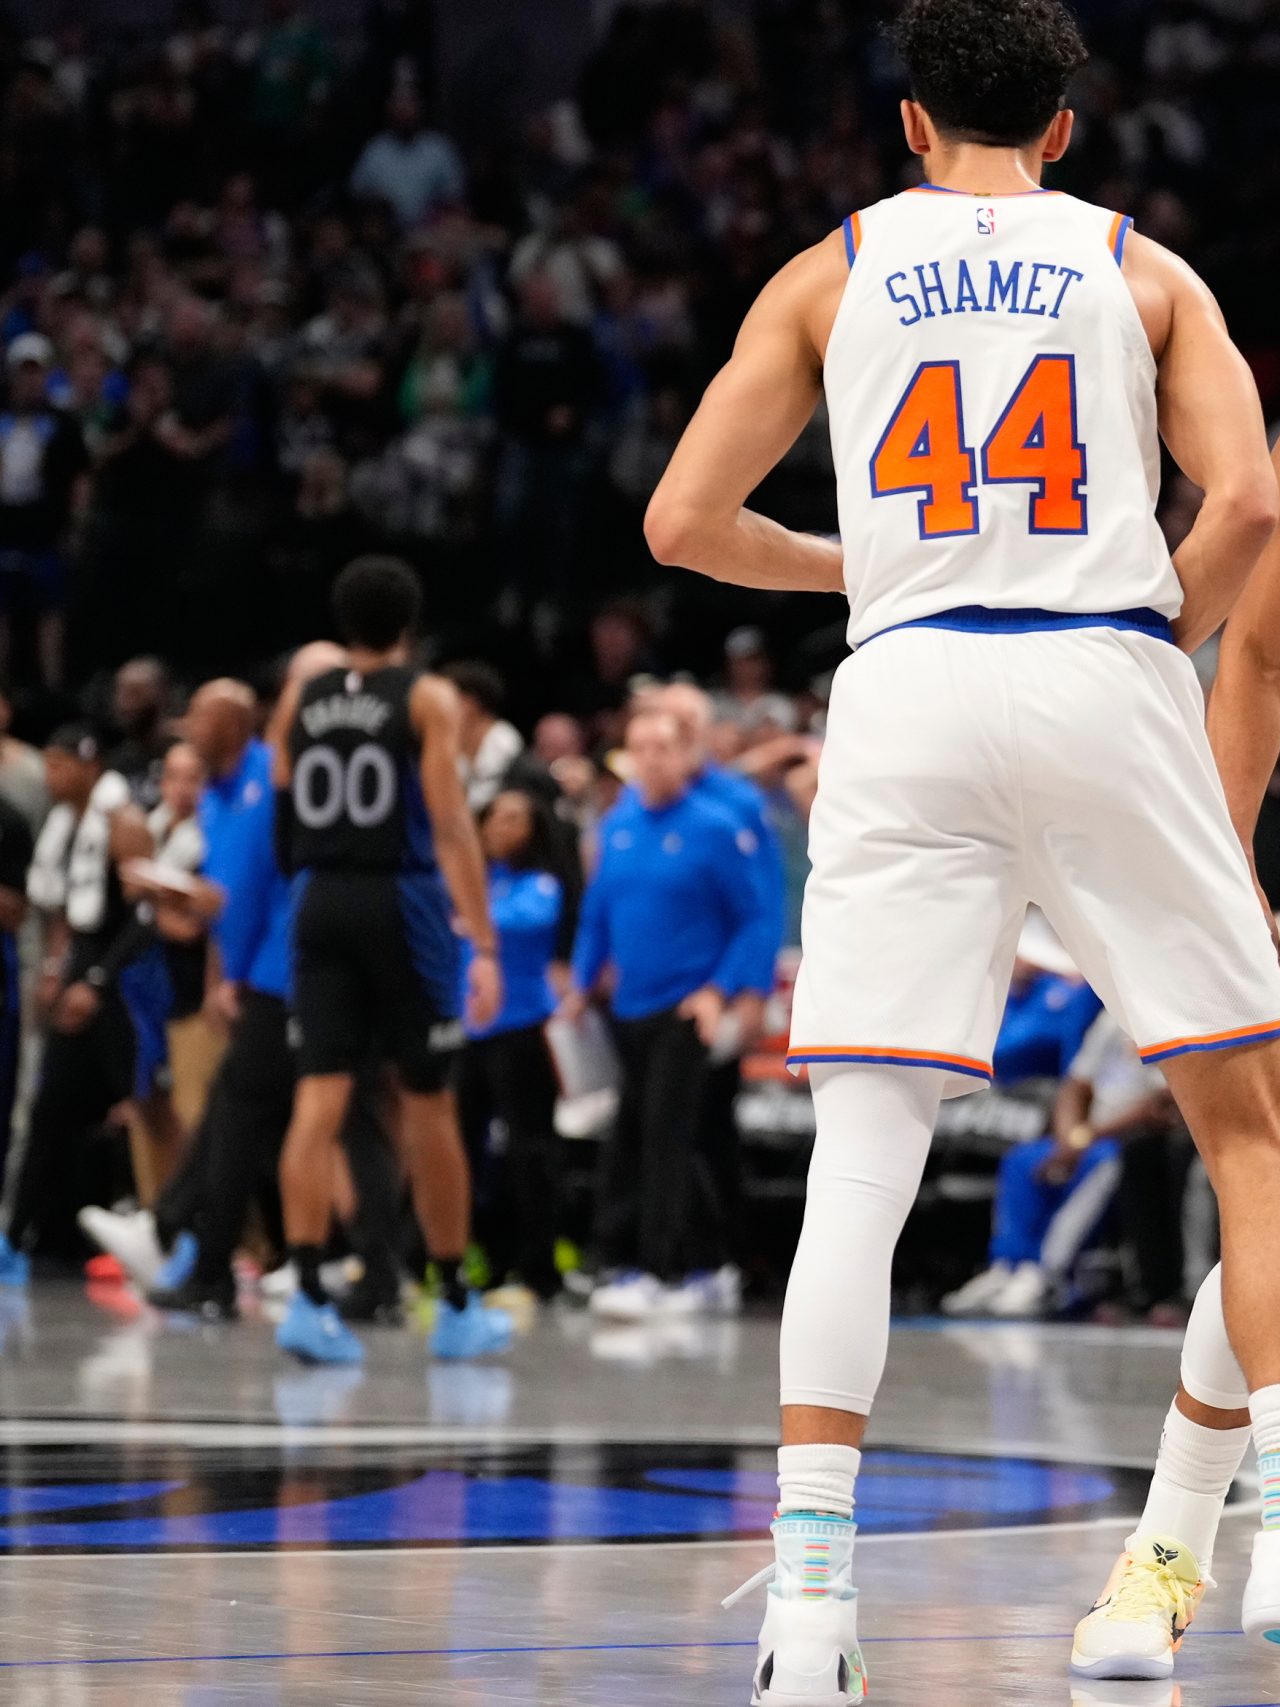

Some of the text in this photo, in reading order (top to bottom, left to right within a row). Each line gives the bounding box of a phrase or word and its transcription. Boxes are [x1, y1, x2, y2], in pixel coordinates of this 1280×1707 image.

[885, 259, 1083, 326] SHAMET
[869, 353, 1088, 540] 44
[294, 743, 393, 829] 00
